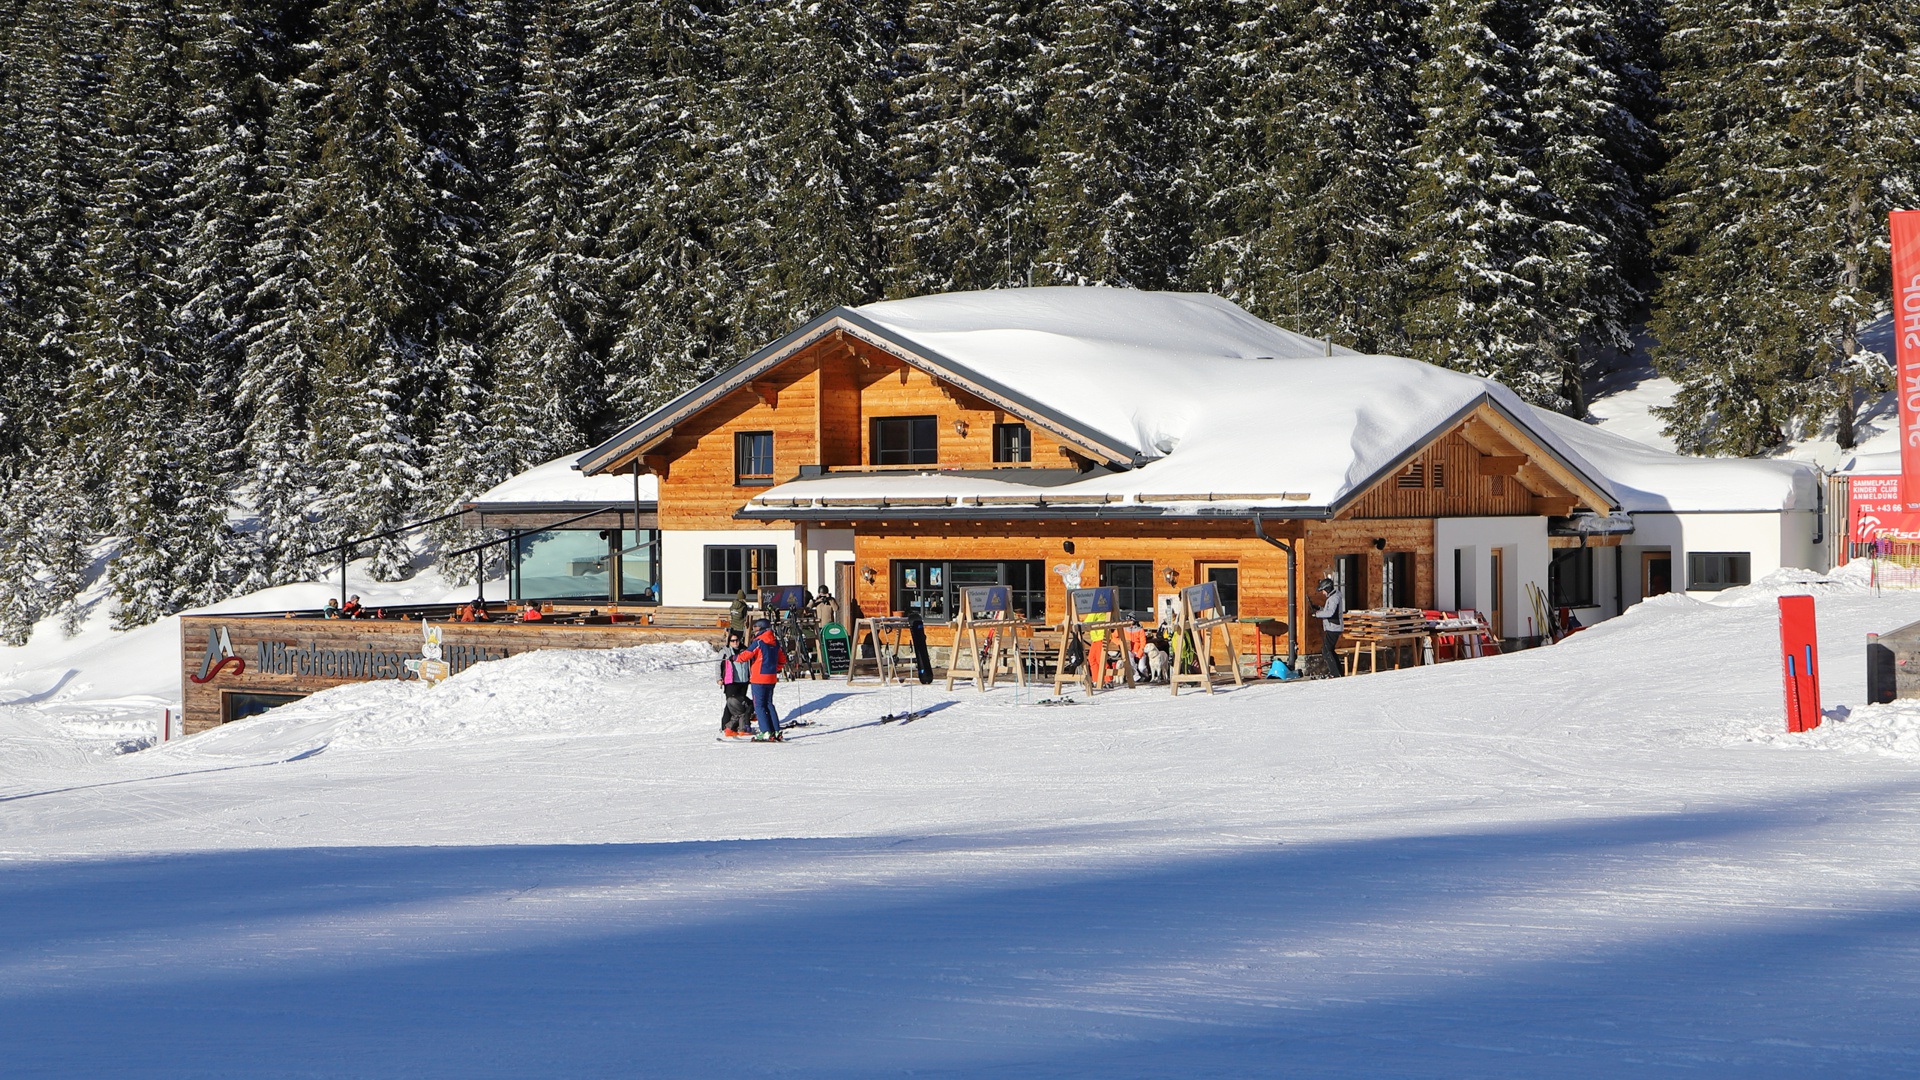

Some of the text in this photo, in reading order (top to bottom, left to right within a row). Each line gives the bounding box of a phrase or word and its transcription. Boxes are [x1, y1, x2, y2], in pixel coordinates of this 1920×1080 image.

[1860, 504, 1875, 512] TEL
[1876, 504, 1891, 512] +43
[1872, 528, 1920, 539] Tritsc
[440, 644, 502, 677] Hüt
